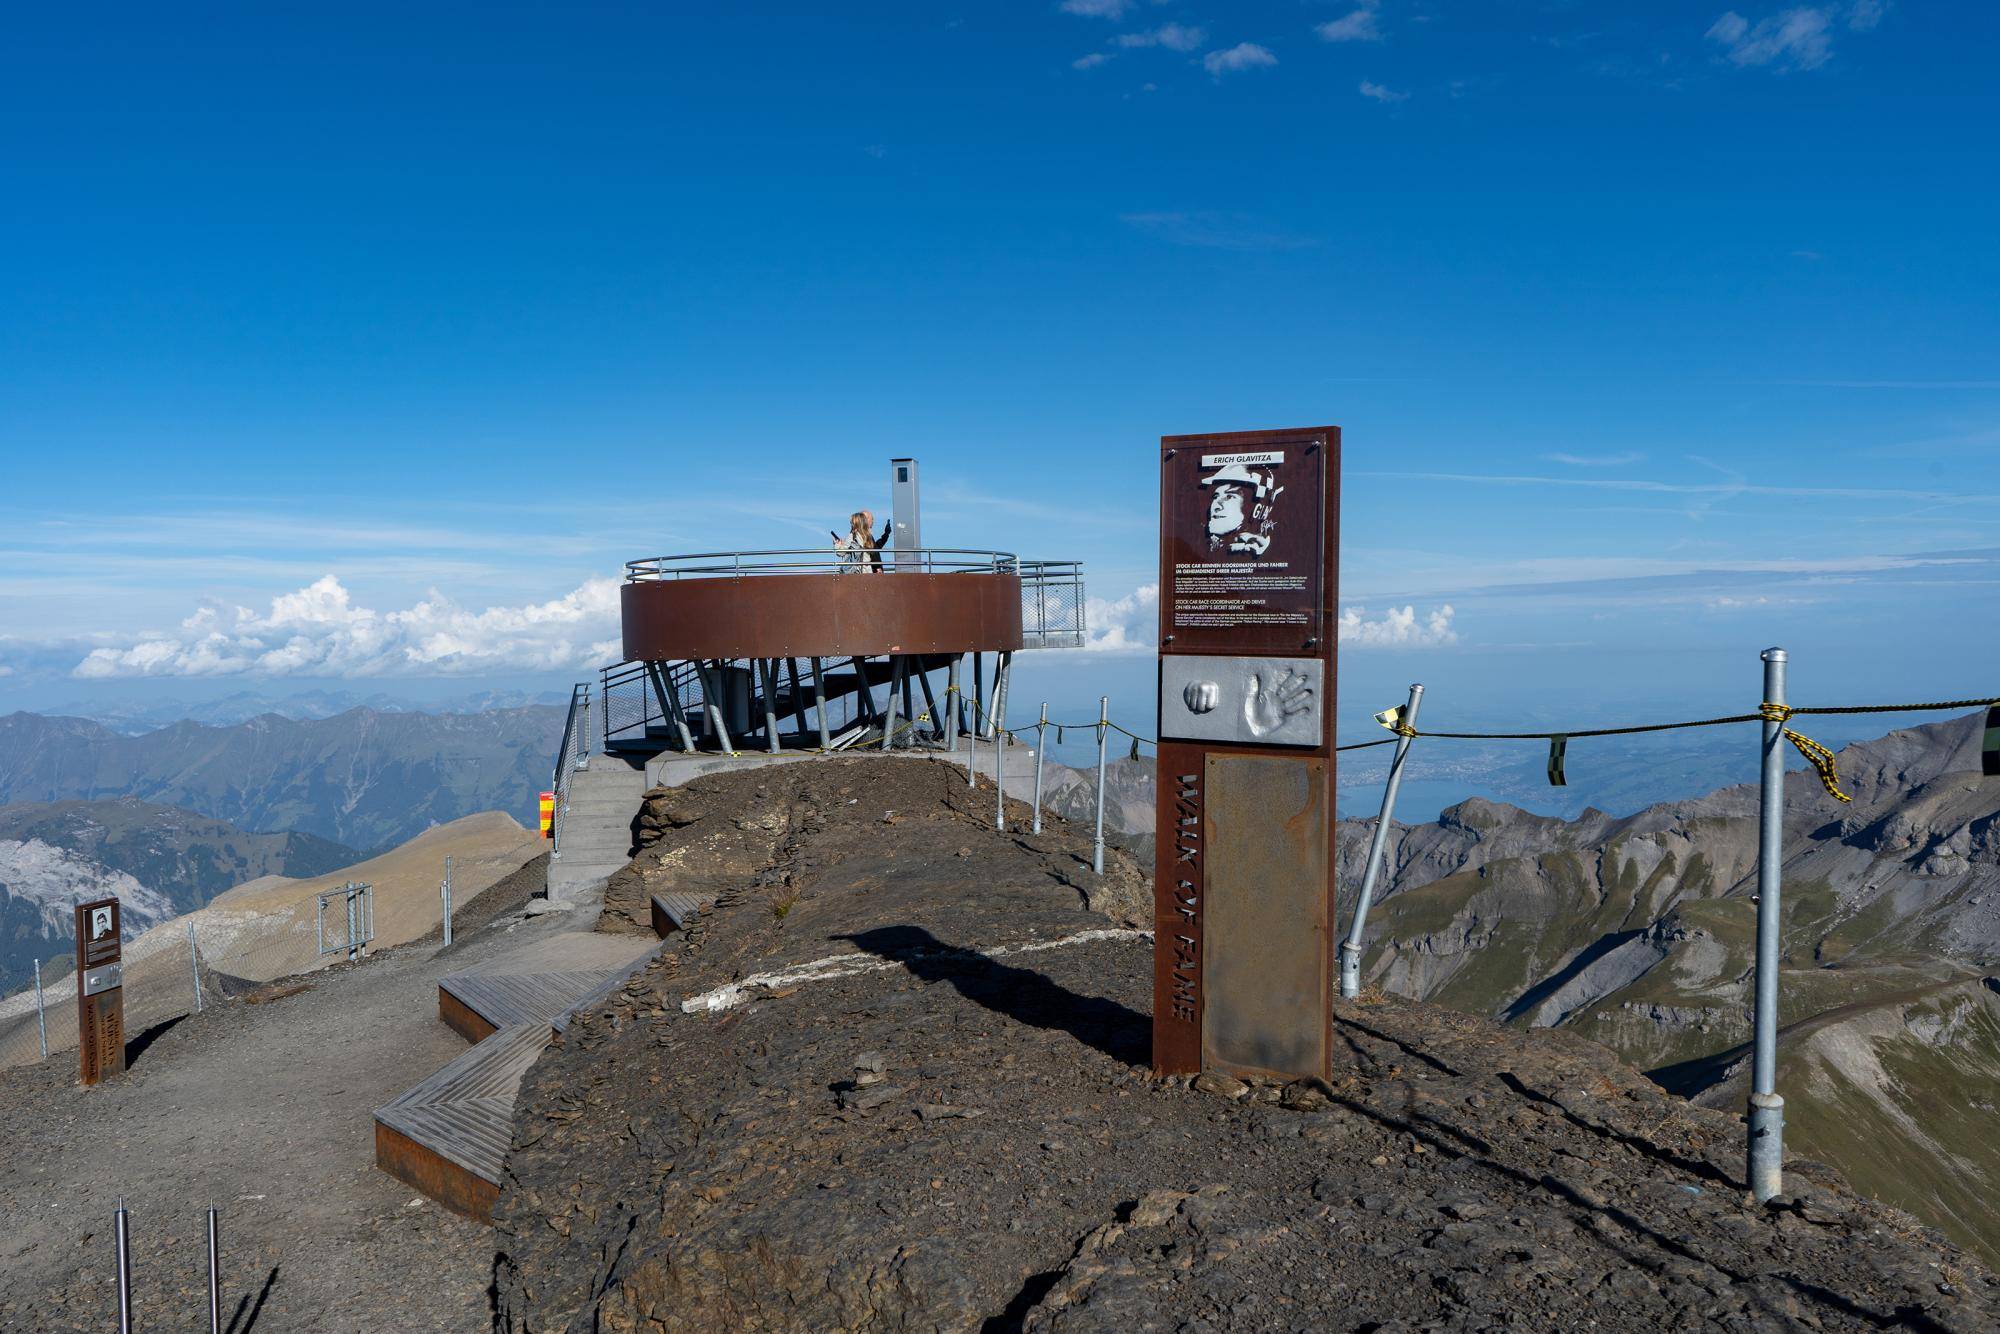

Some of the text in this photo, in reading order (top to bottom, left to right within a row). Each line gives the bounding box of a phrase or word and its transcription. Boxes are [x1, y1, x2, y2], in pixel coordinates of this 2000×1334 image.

[1236, 454, 1272, 462] GLAVITZA
[1173, 774, 1198, 1023] WALK OF FAME
